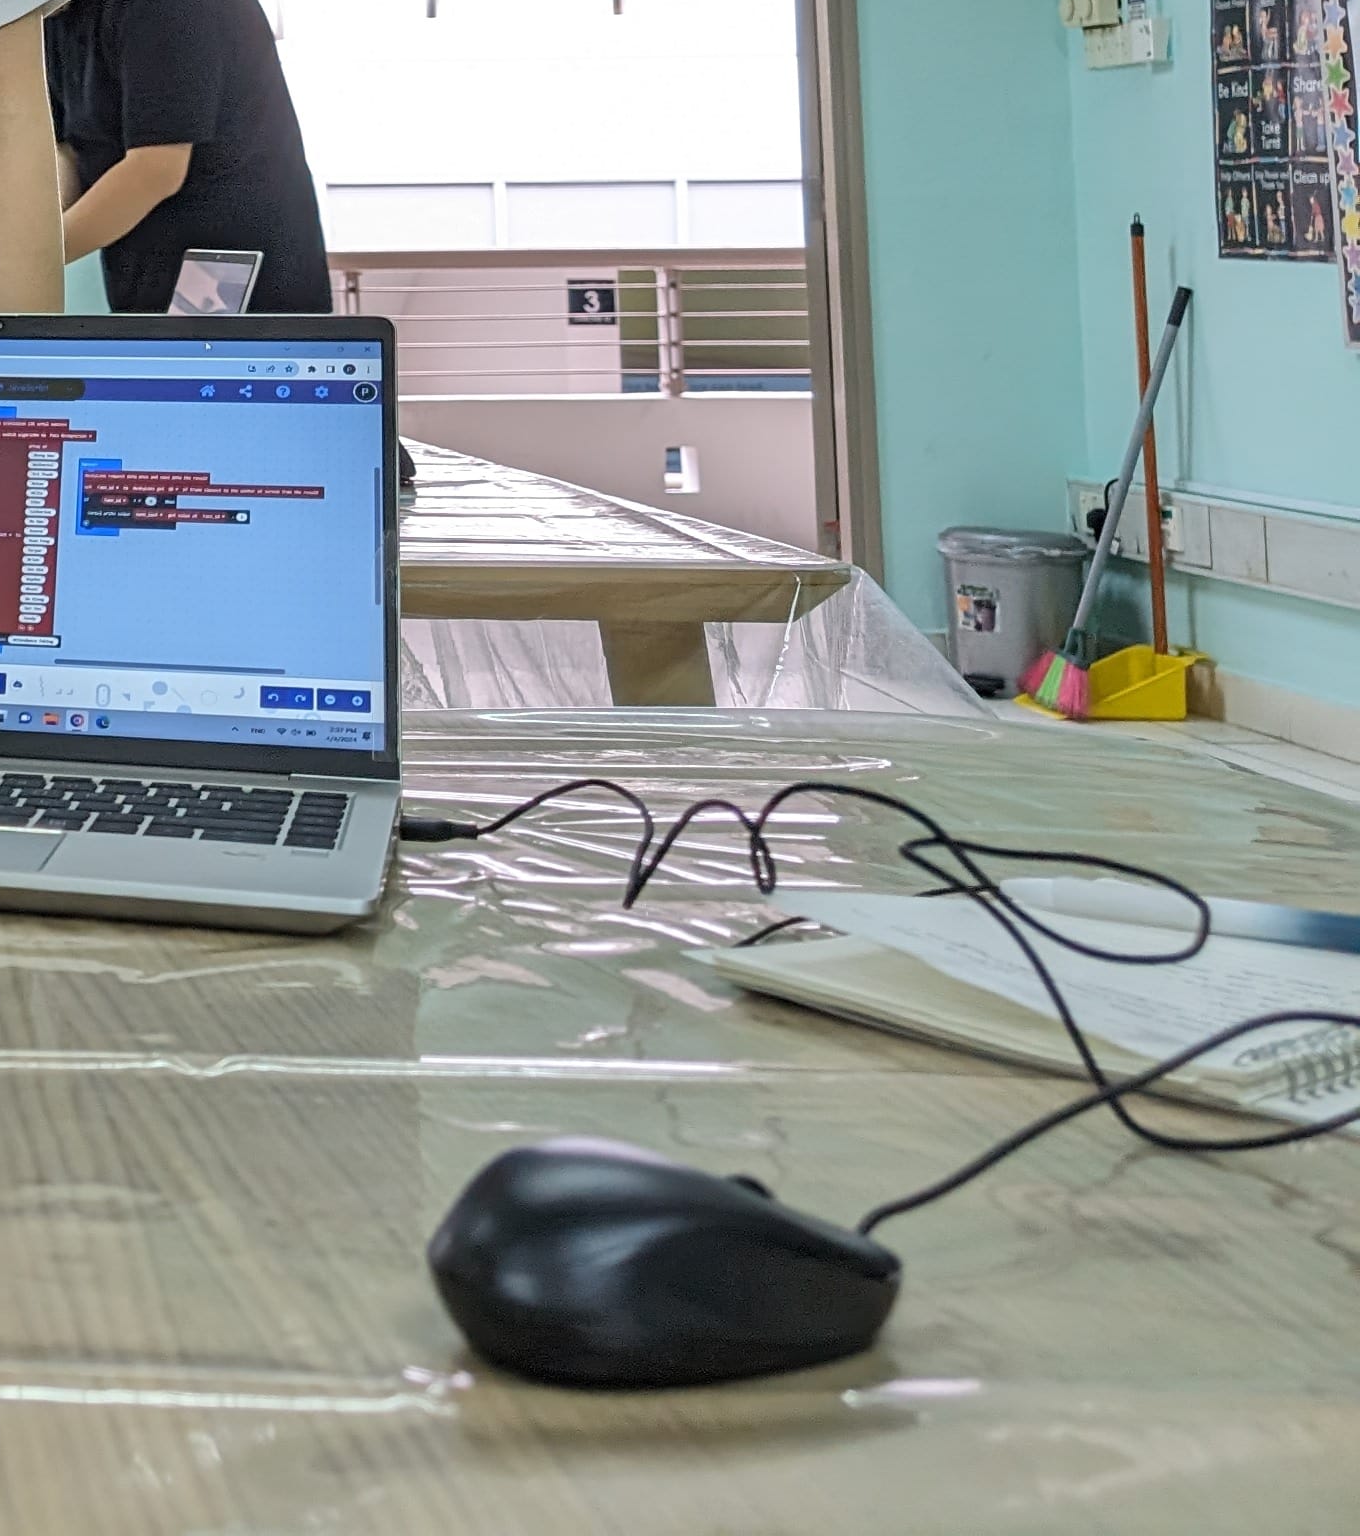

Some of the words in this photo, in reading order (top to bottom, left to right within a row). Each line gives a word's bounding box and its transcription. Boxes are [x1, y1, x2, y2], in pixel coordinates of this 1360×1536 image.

[1218, 83, 1229, 99] Be
[1231, 81, 1248, 98] Kind
[1293, 169, 1318, 185] Clean
[583, 290, 600, 314] 3
[361, 387, 369, 397] P
